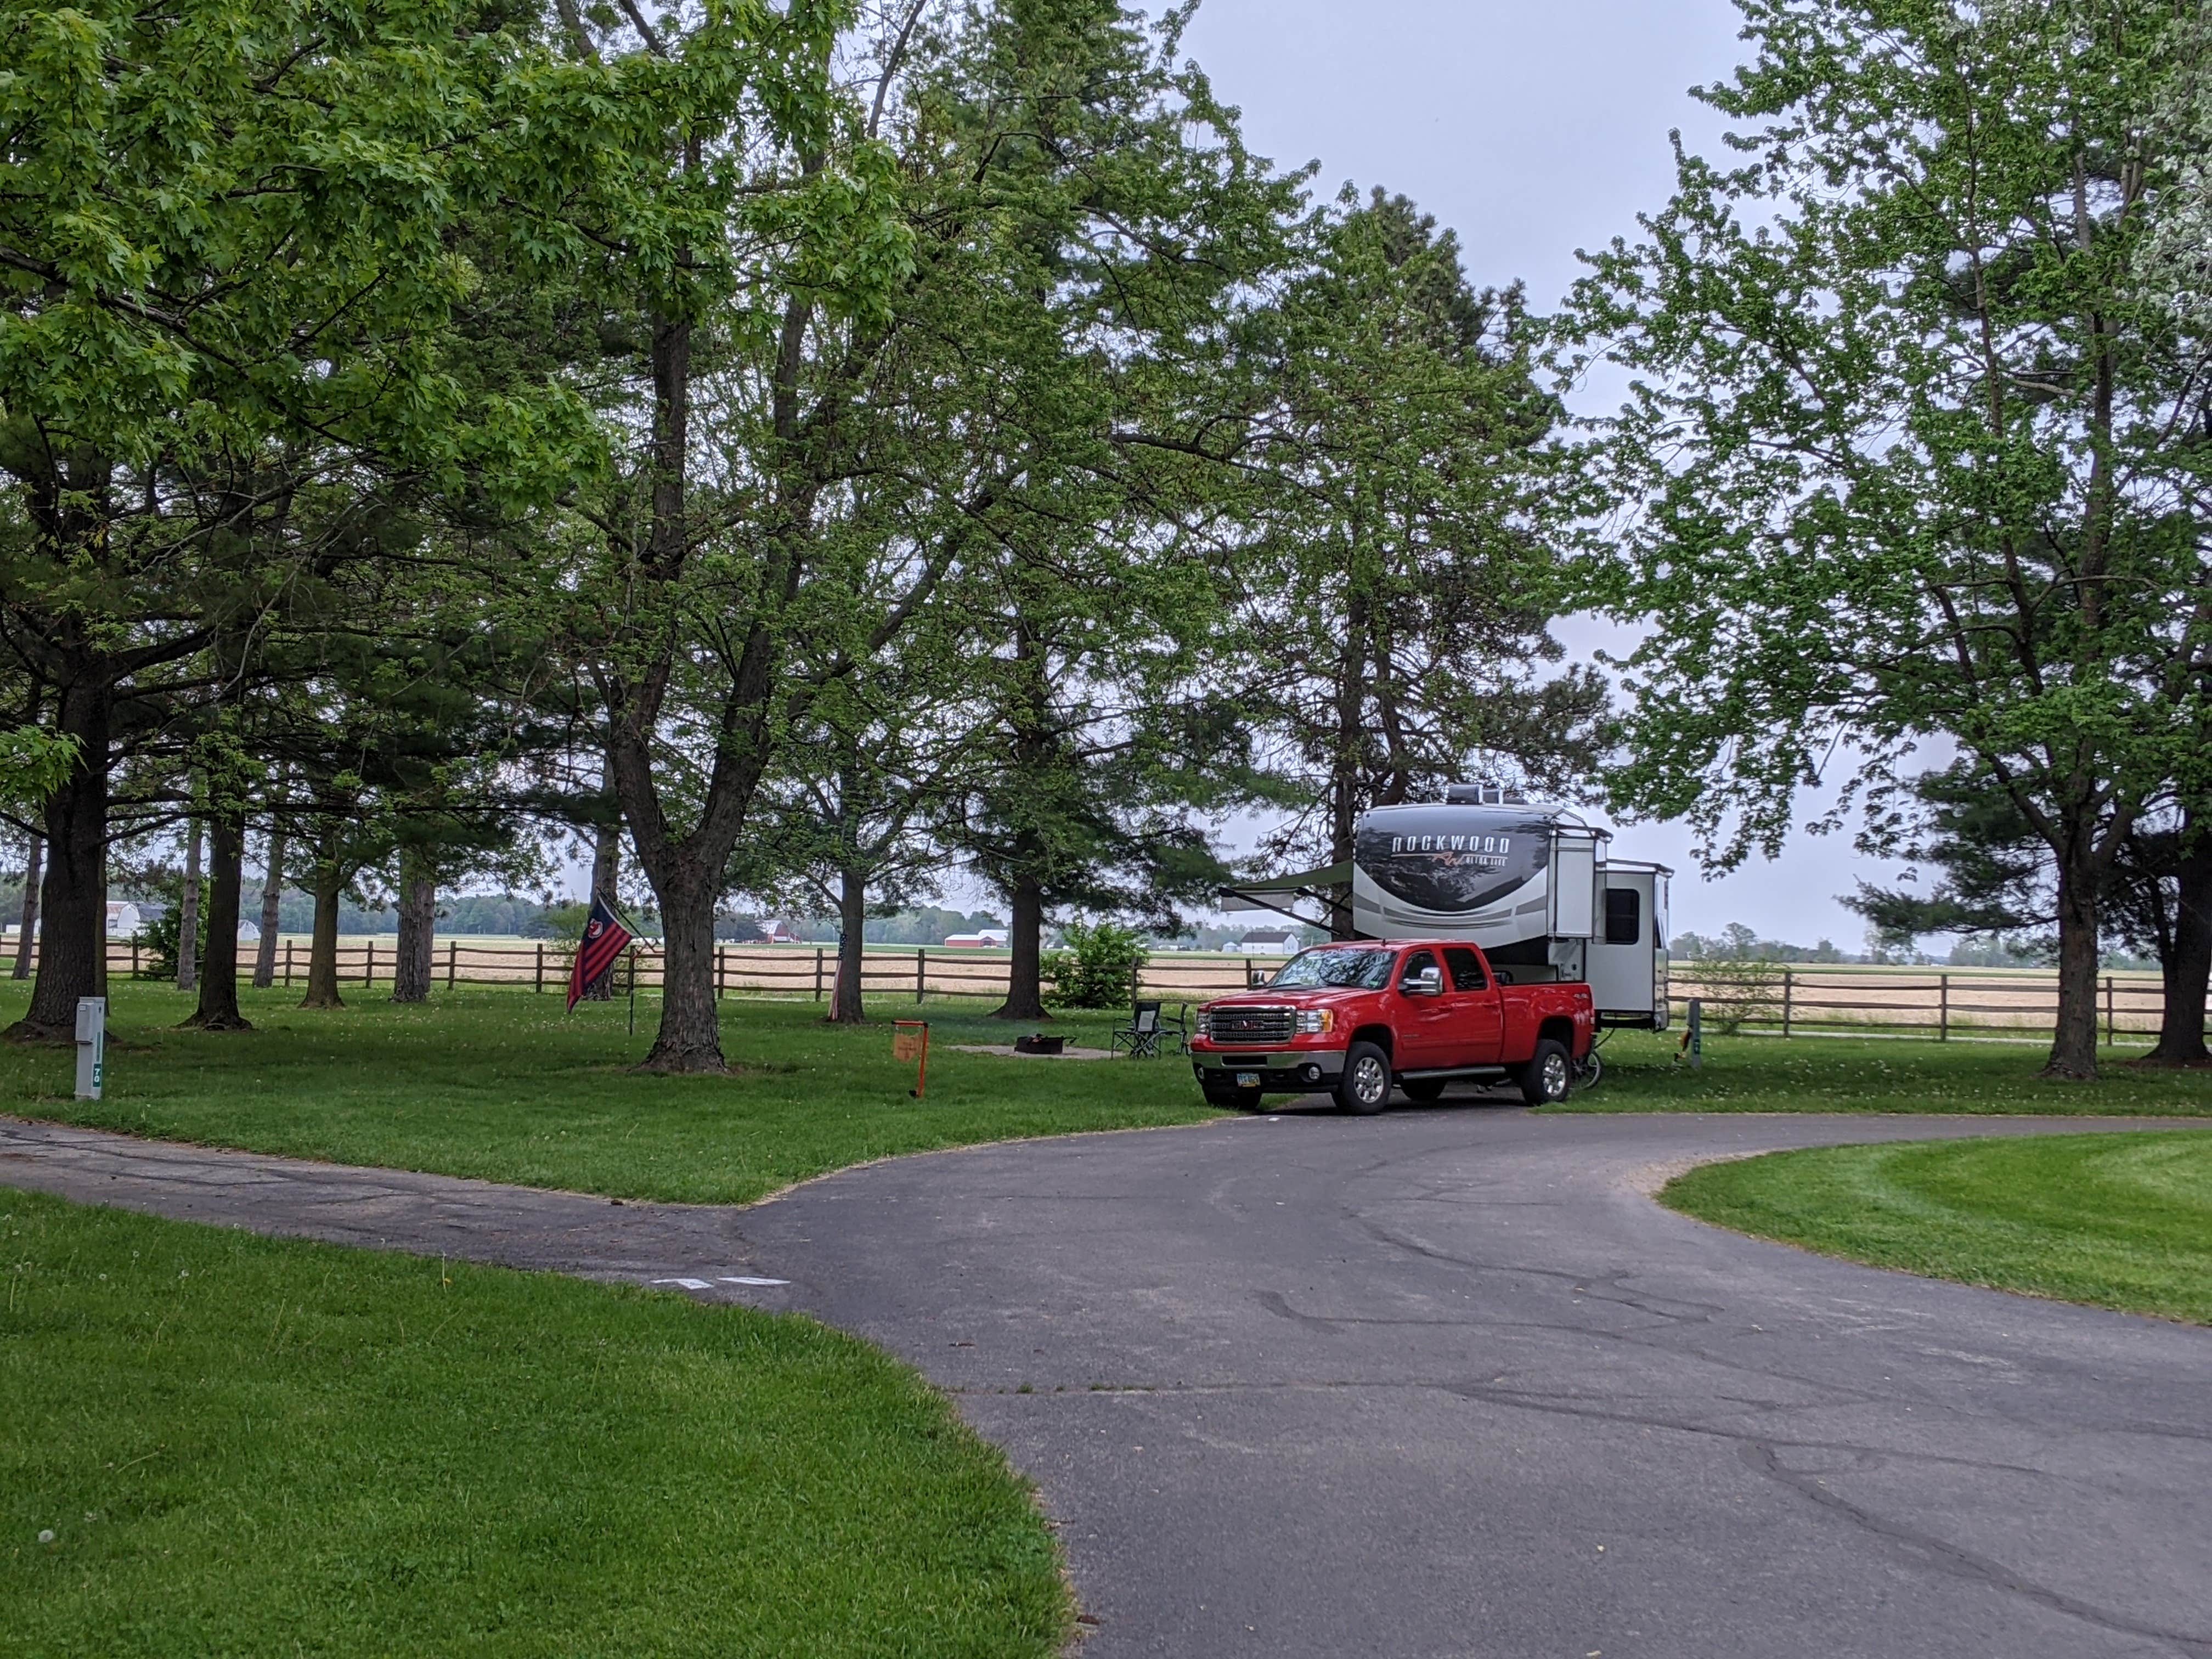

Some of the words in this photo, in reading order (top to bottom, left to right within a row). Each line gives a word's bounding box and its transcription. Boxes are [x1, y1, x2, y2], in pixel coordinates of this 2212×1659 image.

[1392, 835, 1510, 854] ROCKWOOD
[1231, 1020, 1264, 1030] GMC
[94, 1068, 101, 1082] 70
